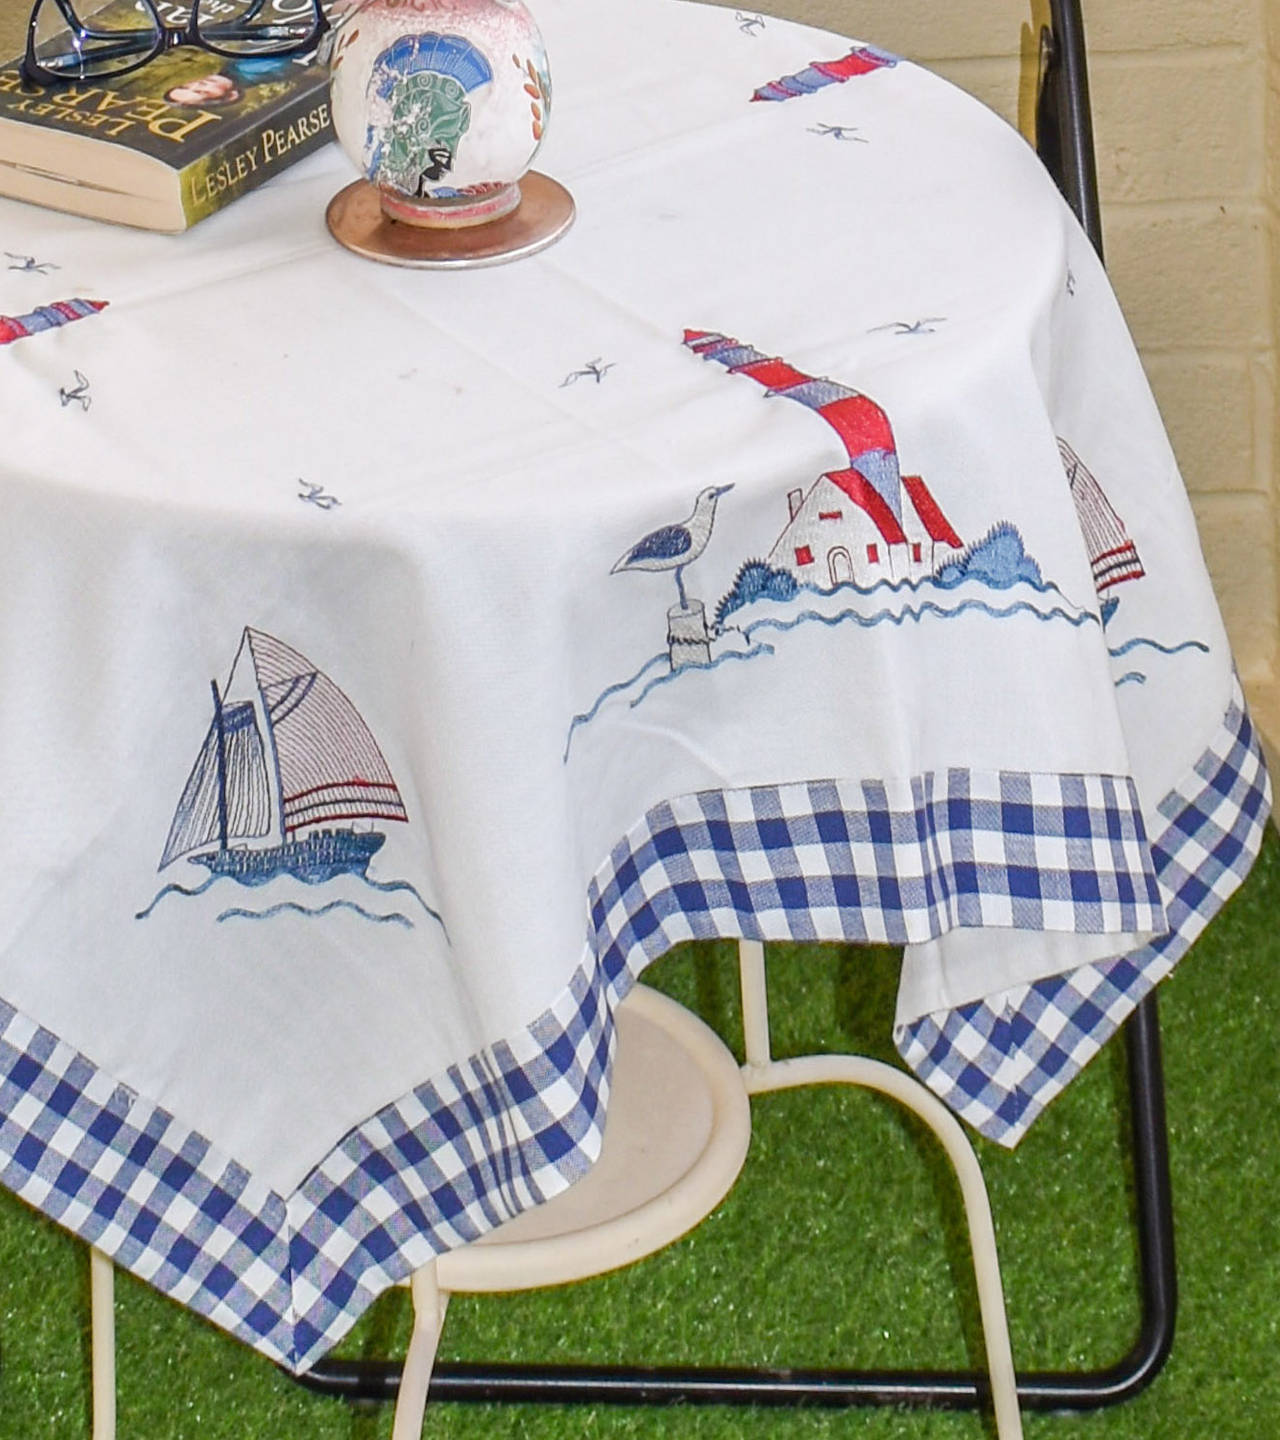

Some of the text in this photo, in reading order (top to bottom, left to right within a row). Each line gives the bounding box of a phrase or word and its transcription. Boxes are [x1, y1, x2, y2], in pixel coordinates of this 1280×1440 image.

[6, 99, 137, 137] LESLEY
[190, 103, 331, 206] LESLEY PEARSE
